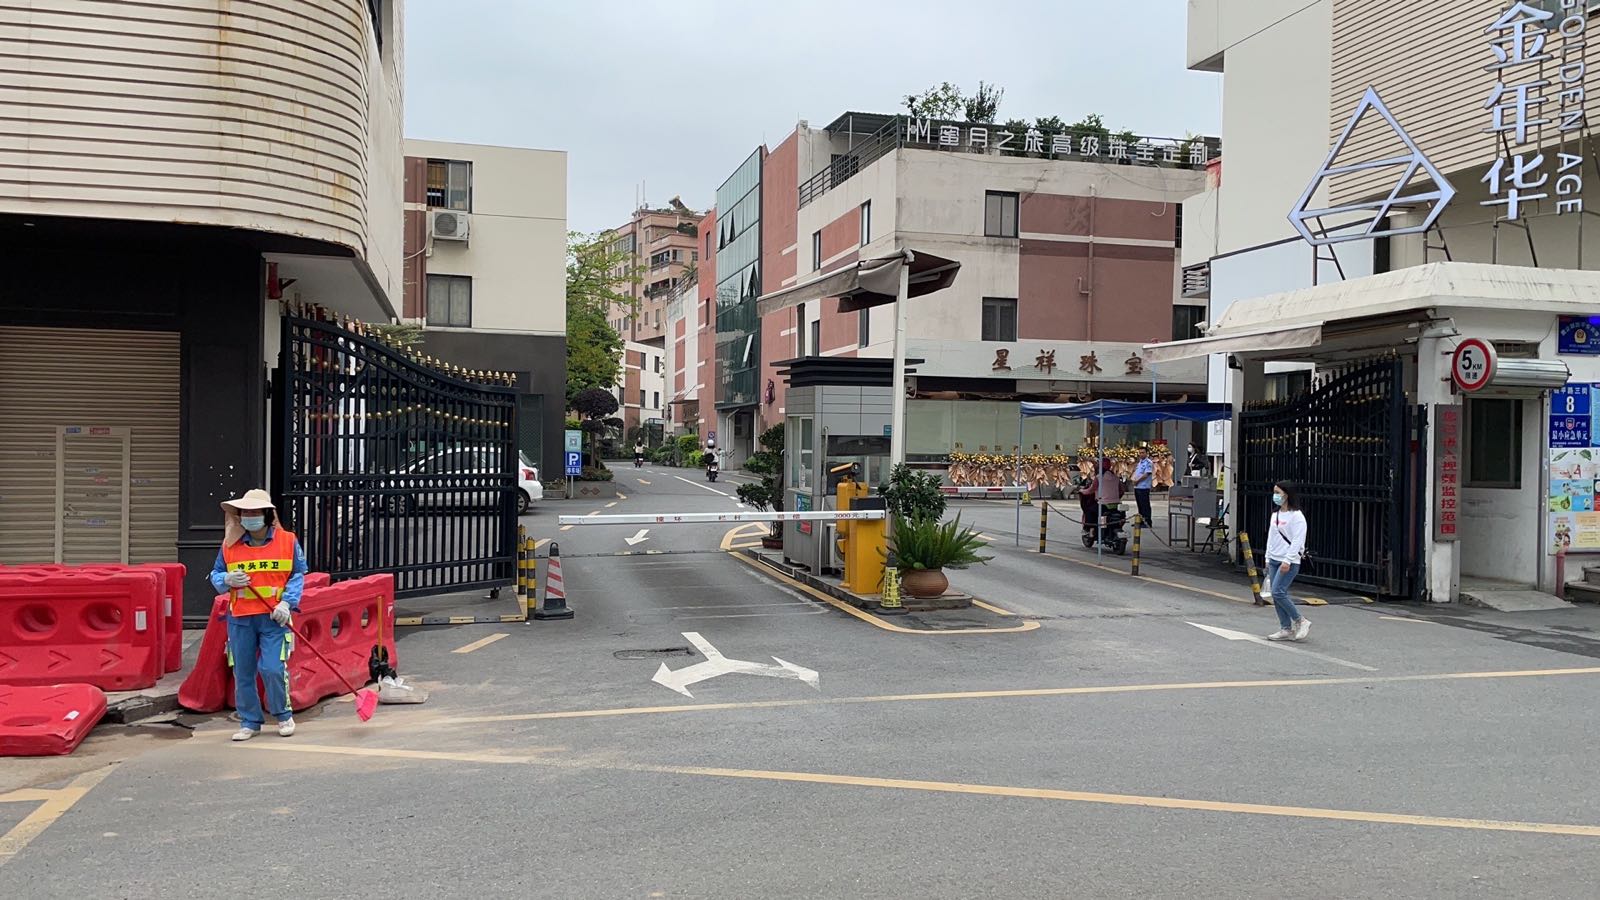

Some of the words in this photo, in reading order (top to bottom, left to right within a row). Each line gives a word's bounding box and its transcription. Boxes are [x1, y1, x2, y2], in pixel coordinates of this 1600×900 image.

[1480, 1, 1554, 220] 金年华
[1556, 152, 1583, 215] AGE
[992, 348, 1144, 375] 星祥珠宝
[1566, 395, 1575, 413] 8
[568, 452, 579, 466] P
